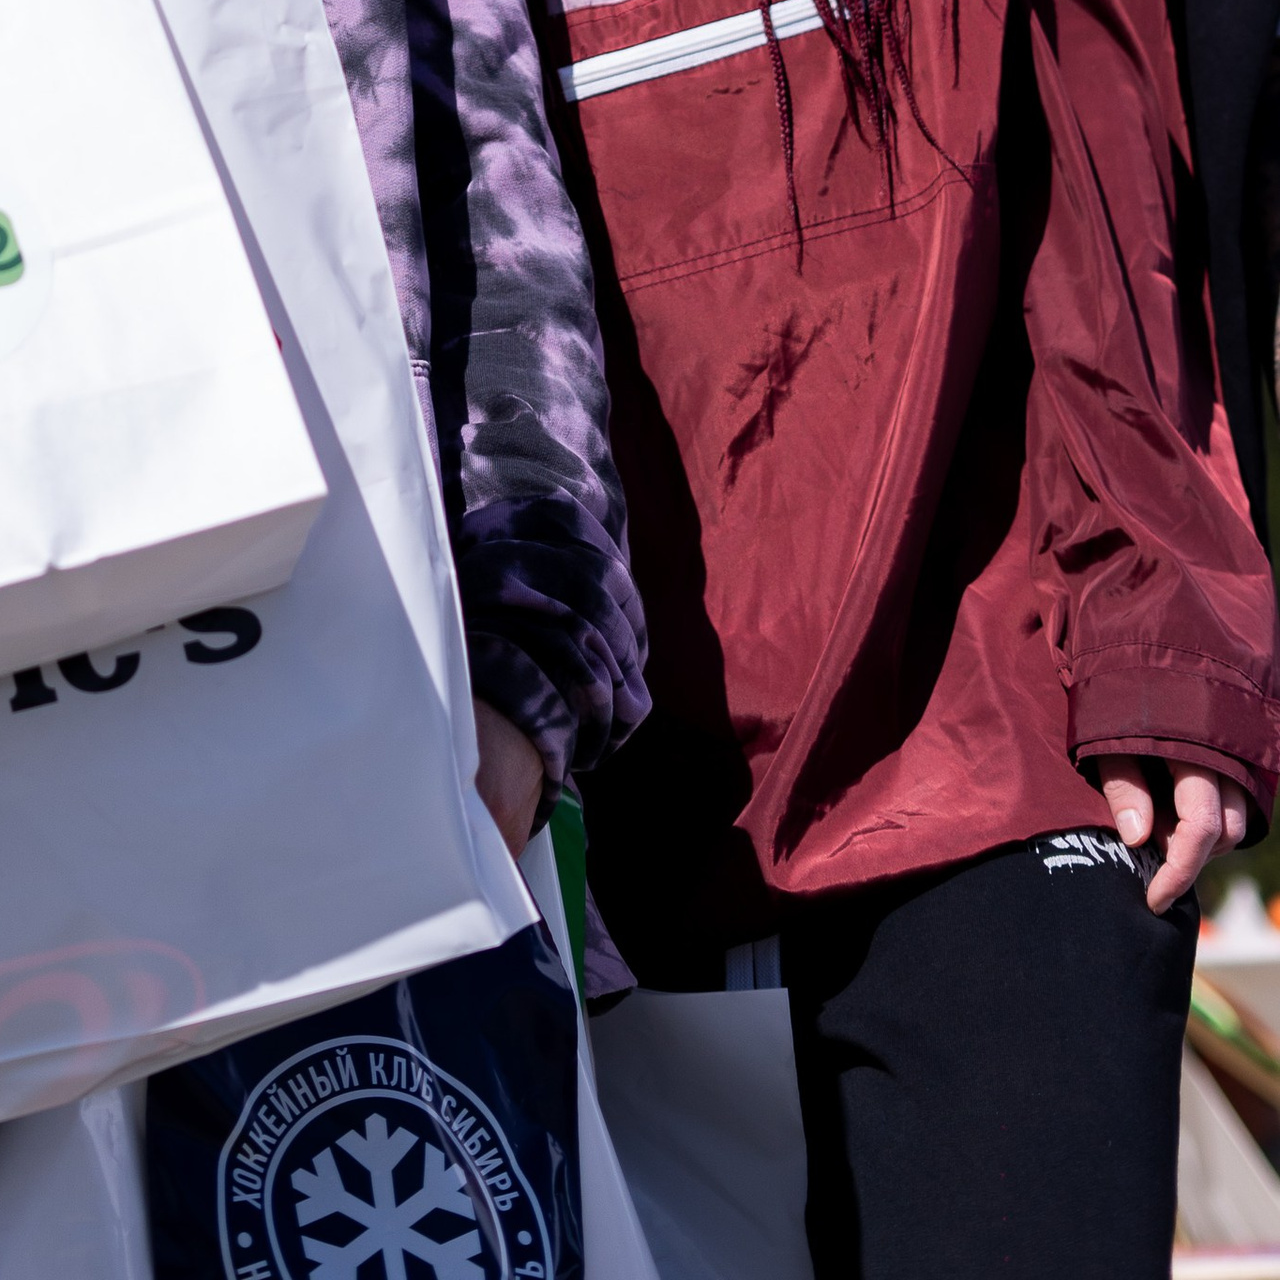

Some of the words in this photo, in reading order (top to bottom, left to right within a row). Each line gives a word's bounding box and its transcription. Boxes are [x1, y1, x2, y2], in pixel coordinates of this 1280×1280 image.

[231, 1047, 360, 1210] ХОККЕЙНЫЙ
[368, 1052, 435, 1103] КЛУБ
[440, 1094, 520, 1213] СИБИРЬ
